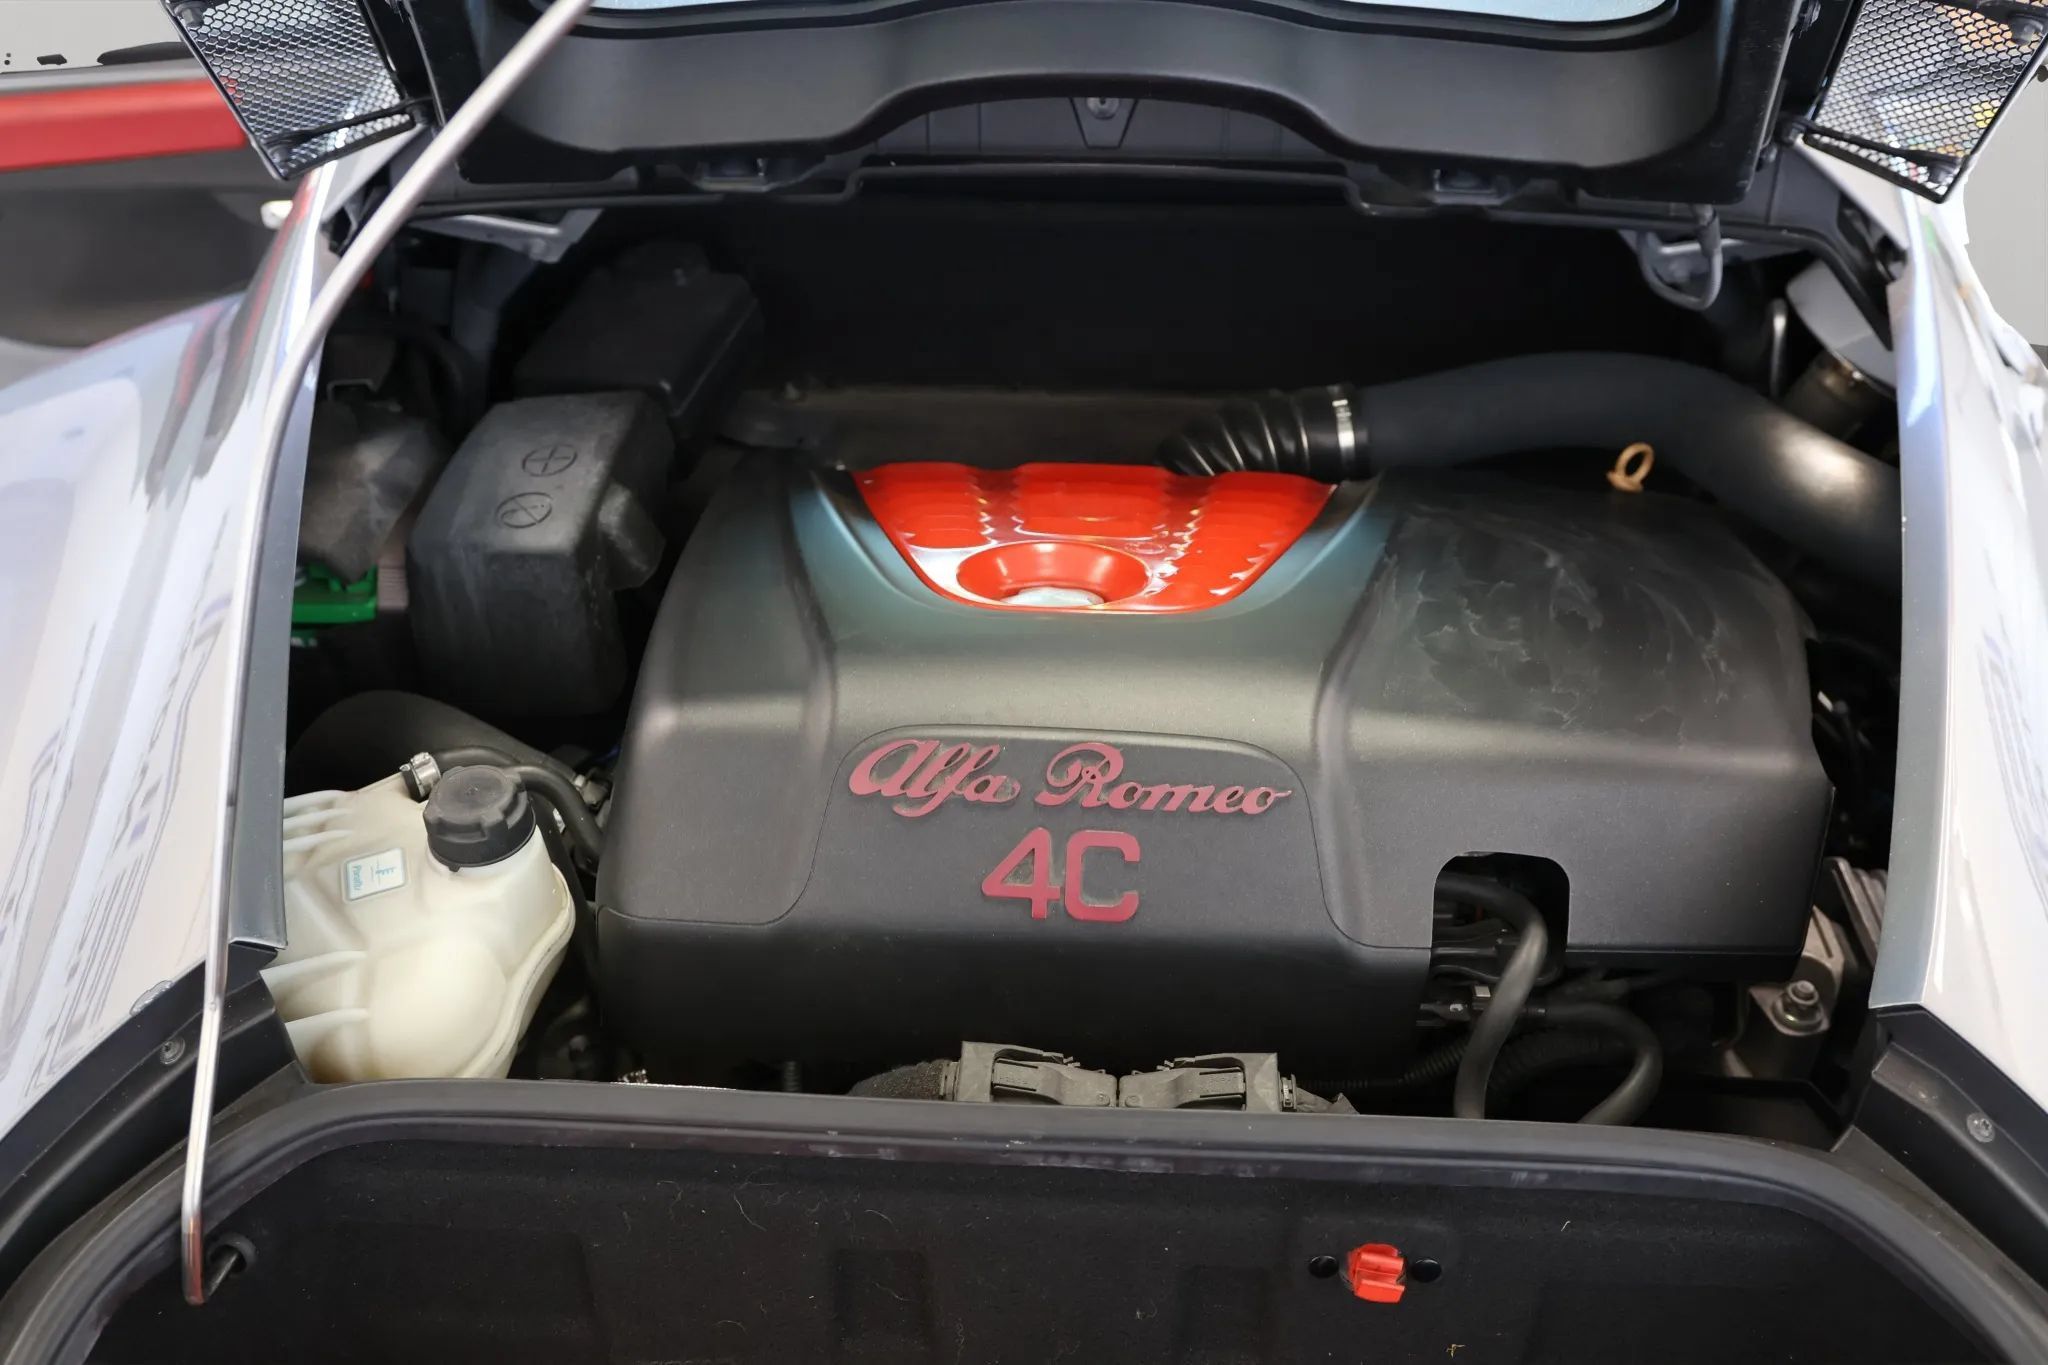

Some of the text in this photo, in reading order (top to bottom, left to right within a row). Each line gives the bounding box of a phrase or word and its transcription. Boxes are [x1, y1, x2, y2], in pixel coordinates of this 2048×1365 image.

[849, 739, 1292, 817] Alfa Romeo
[981, 827, 1140, 922] 4C
